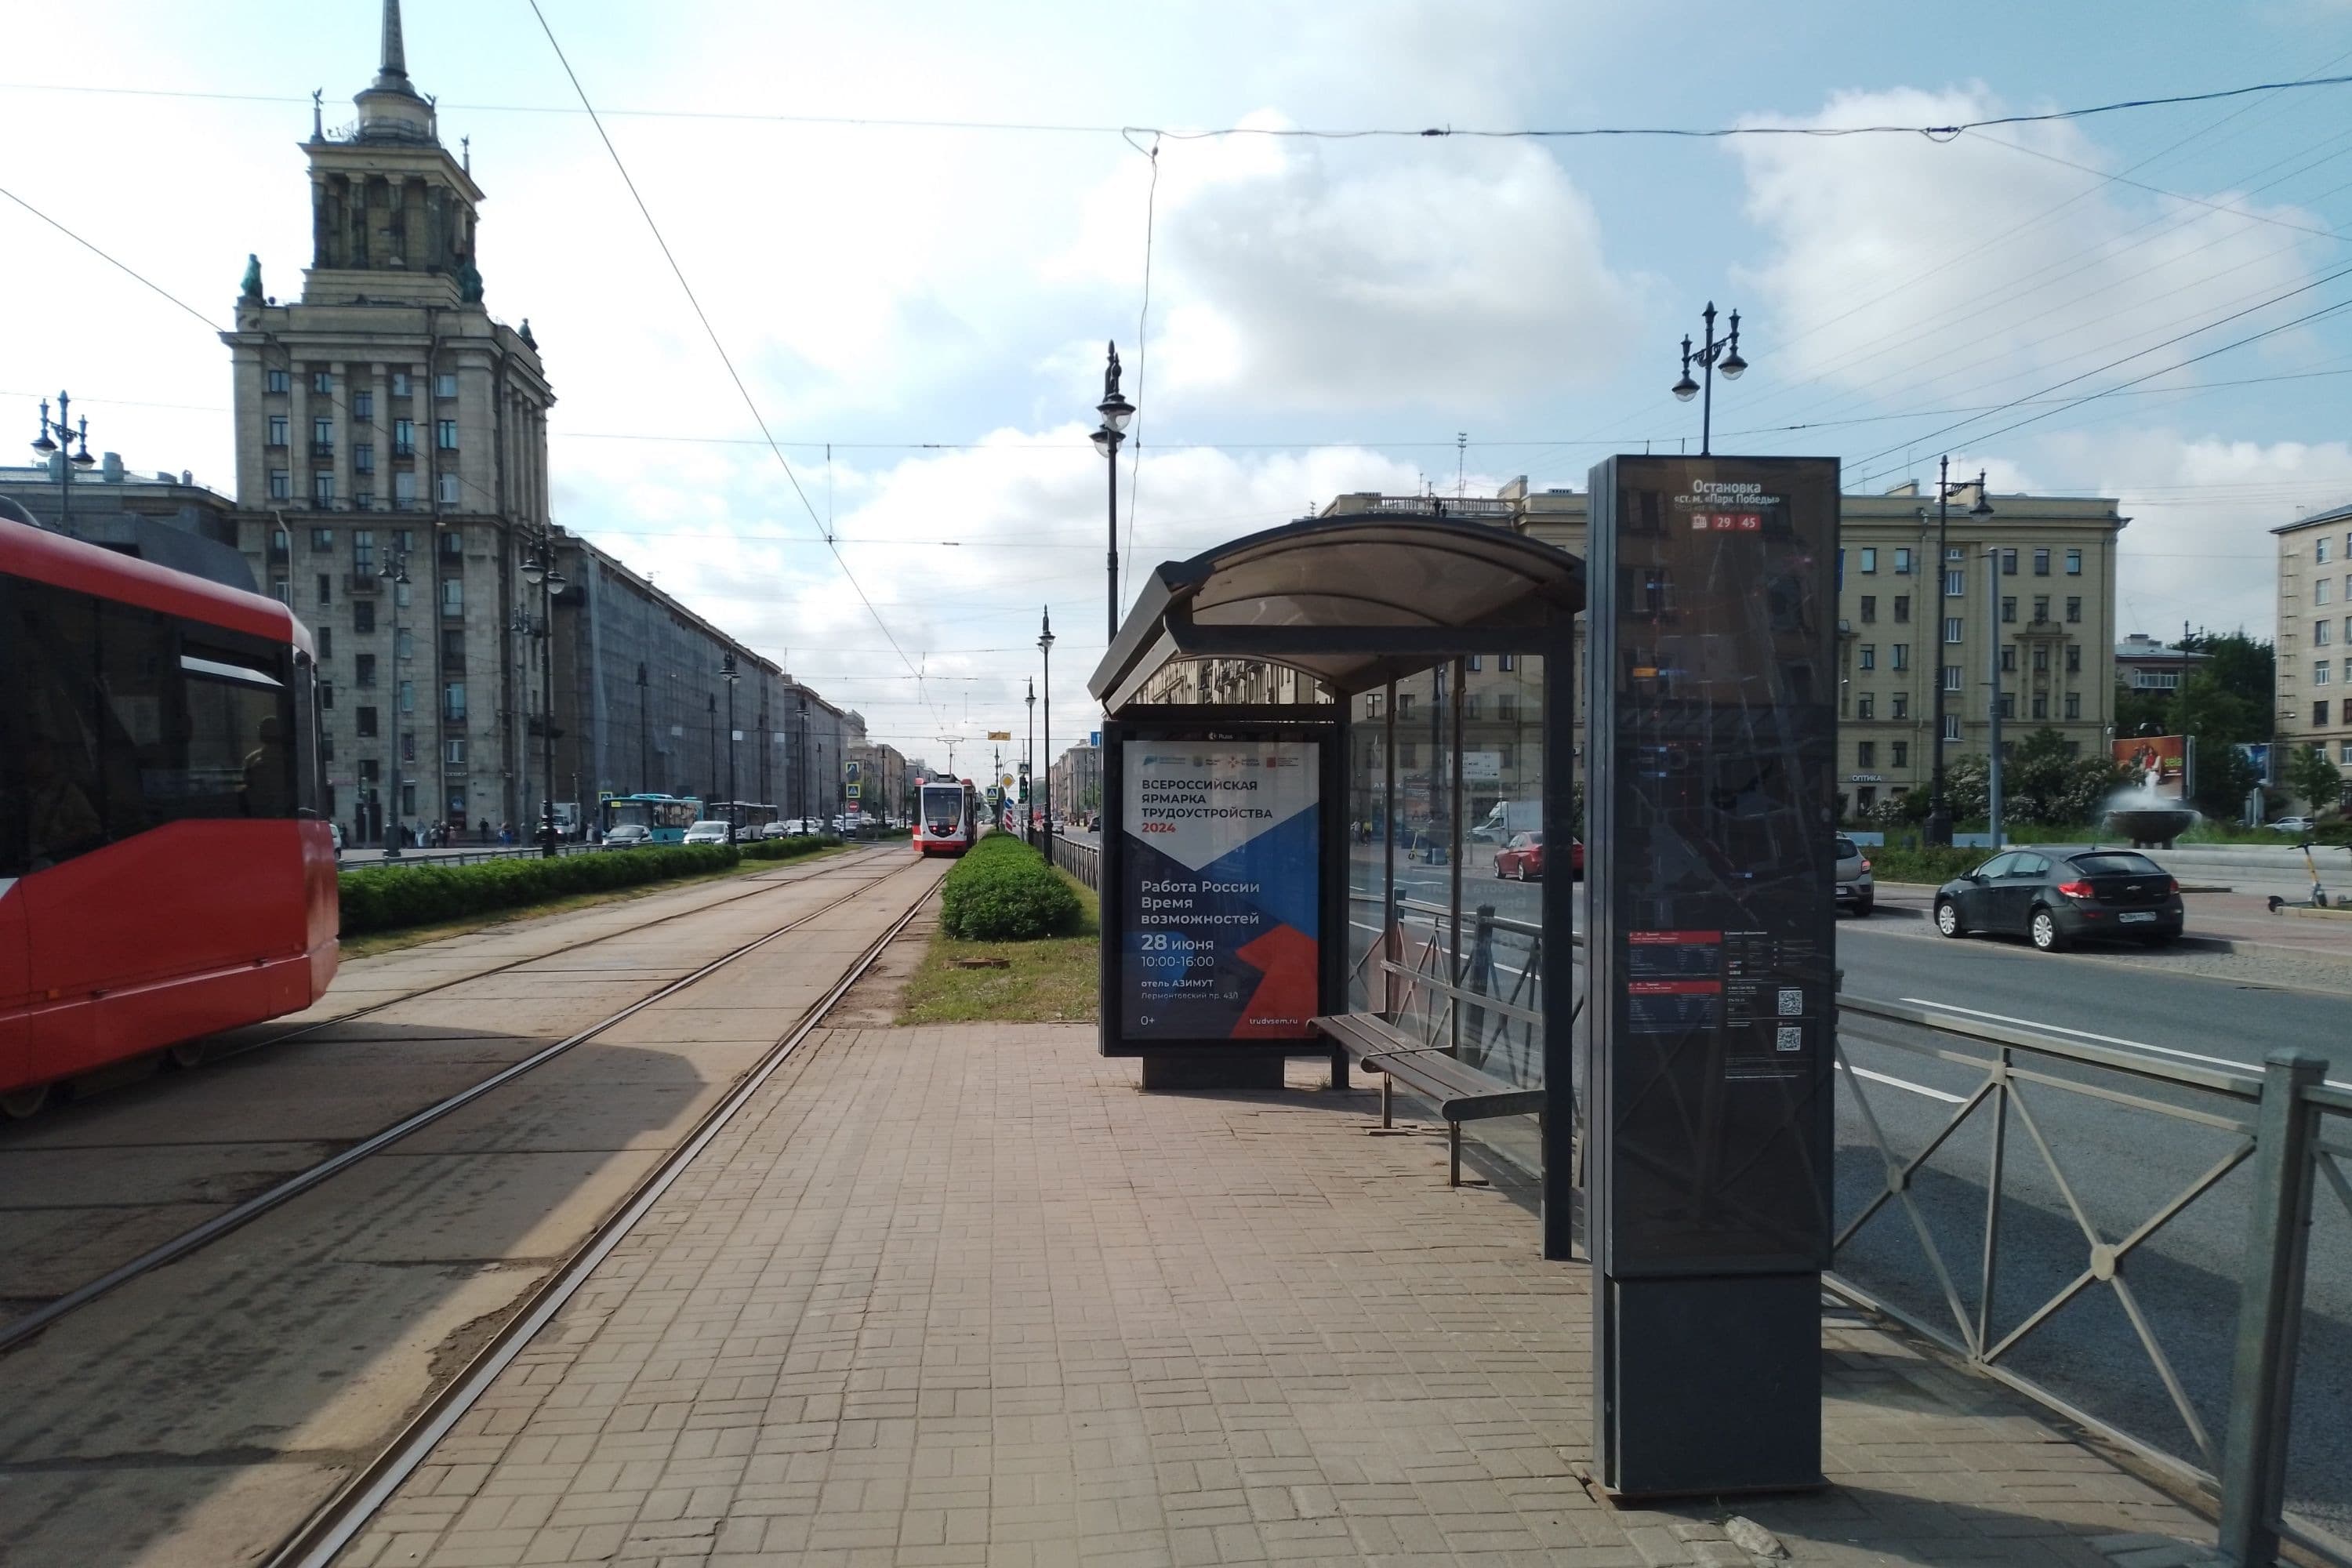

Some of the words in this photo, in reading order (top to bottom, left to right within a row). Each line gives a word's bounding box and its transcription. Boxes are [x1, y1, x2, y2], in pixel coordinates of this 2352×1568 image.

[1693, 479, 1762, 493] Остановка
[1705, 494, 1734, 505] «Парк
[1736, 494, 1780, 505] Победы»
[1717, 517, 1731, 528] 29
[1741, 517, 1756, 528] 45
[1142, 779, 1258, 790] ВСЕРОССИЙСКАЯ
[1142, 793, 1207, 804] ЯРМАРКА
[1142, 807, 1273, 820] ТРУДОУСТРОЙСТВА
[1142, 822, 1176, 833] 2024
[1141, 880, 1197, 893] Работа
[1202, 880, 1260, 893] России
[1141, 896, 1193, 912] Время
[1141, 913, 1260, 925] возможностей
[1141, 934, 1167, 951] 28
[1171, 940, 1214, 951] июня
[1141, 956, 1214, 967] 10:00-16:00
[1172, 978, 1214, 988] АЗИМУТ
[1140, 1016, 1155, 1025] 0+
[1249, 1017, 1298, 1025] trudvsem.ru
